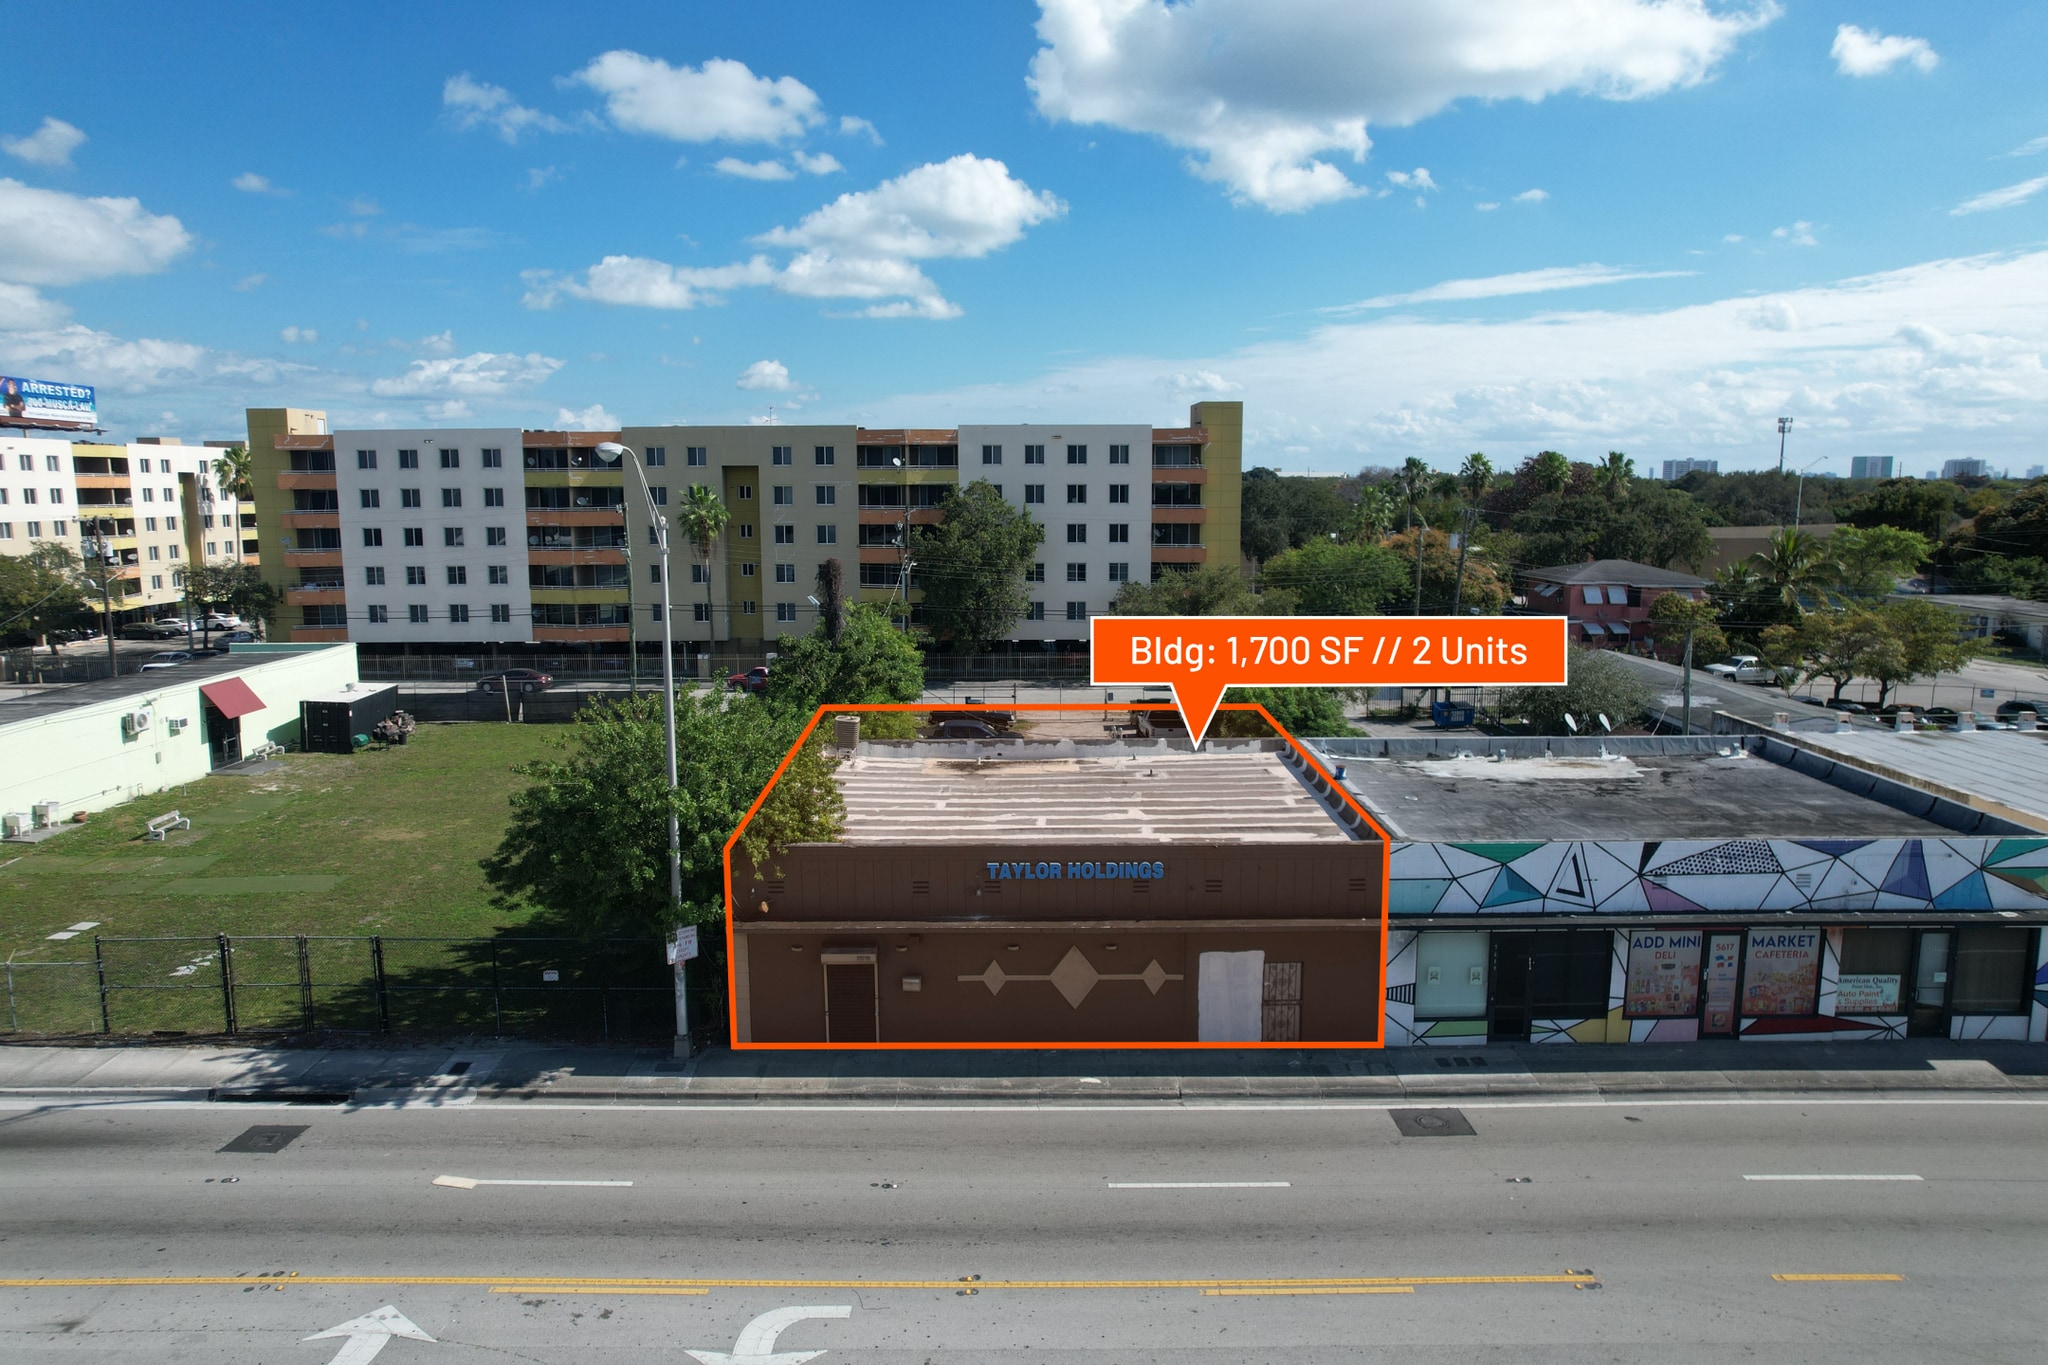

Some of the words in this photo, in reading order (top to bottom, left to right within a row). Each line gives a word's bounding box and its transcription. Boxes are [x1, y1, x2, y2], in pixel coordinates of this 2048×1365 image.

[22, 382, 92, 399] ARRESTED?
[986, 862, 1062, 879] TAYLOR
[1067, 862, 1165, 879] HOLDINGS
[1632, 935, 1665, 949] ADD
[1669, 935, 1701, 948] MINI
[1752, 935, 1816, 948] MARKET
[1715, 943, 1735, 951] 5617
[1654, 951, 1676, 960] DELI
[1754, 950, 1809, 959] CAFETERIA
[1838, 976, 1870, 984] American
[1872, 976, 1898, 985] Quality
[1844, 998, 1878, 1006] Supplies
